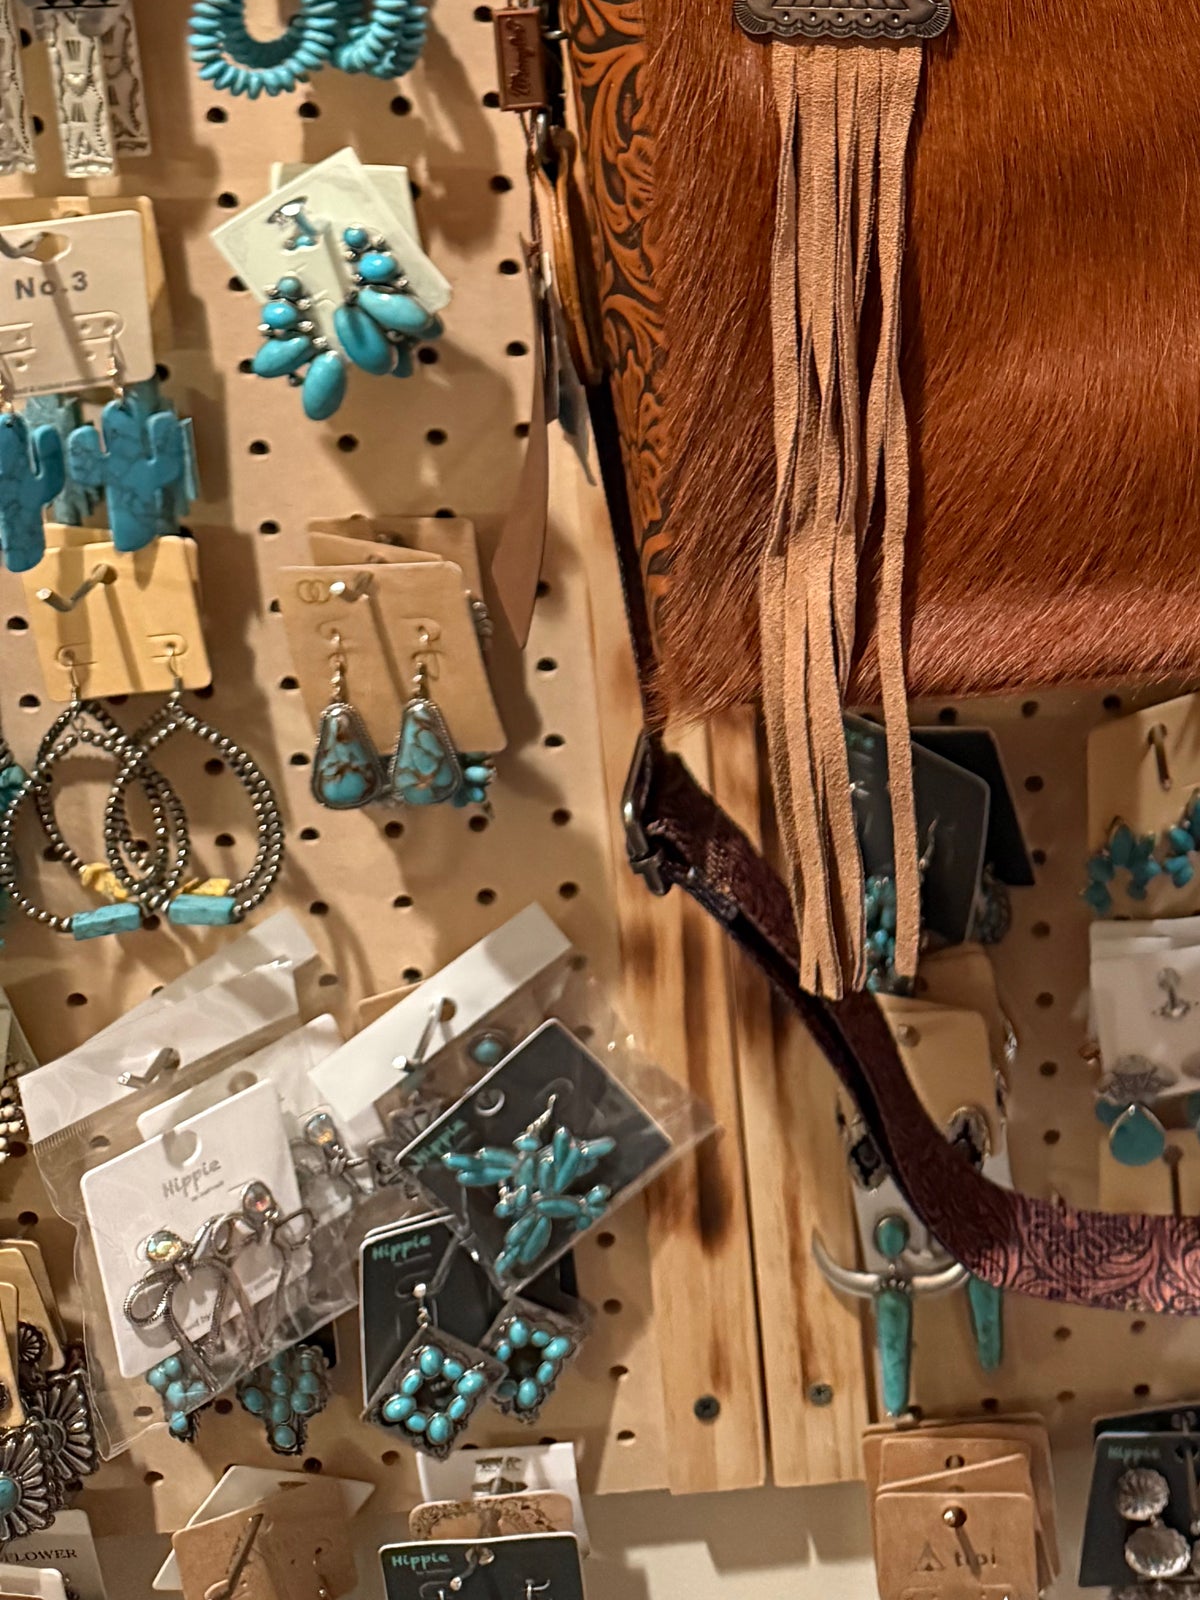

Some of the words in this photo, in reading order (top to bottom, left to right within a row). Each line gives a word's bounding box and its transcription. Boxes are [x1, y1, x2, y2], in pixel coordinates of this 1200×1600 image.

[162, 1160, 222, 1198] Hippie
[372, 1235, 432, 1261] Hippie
[391, 1553, 450, 1571] Hippie
